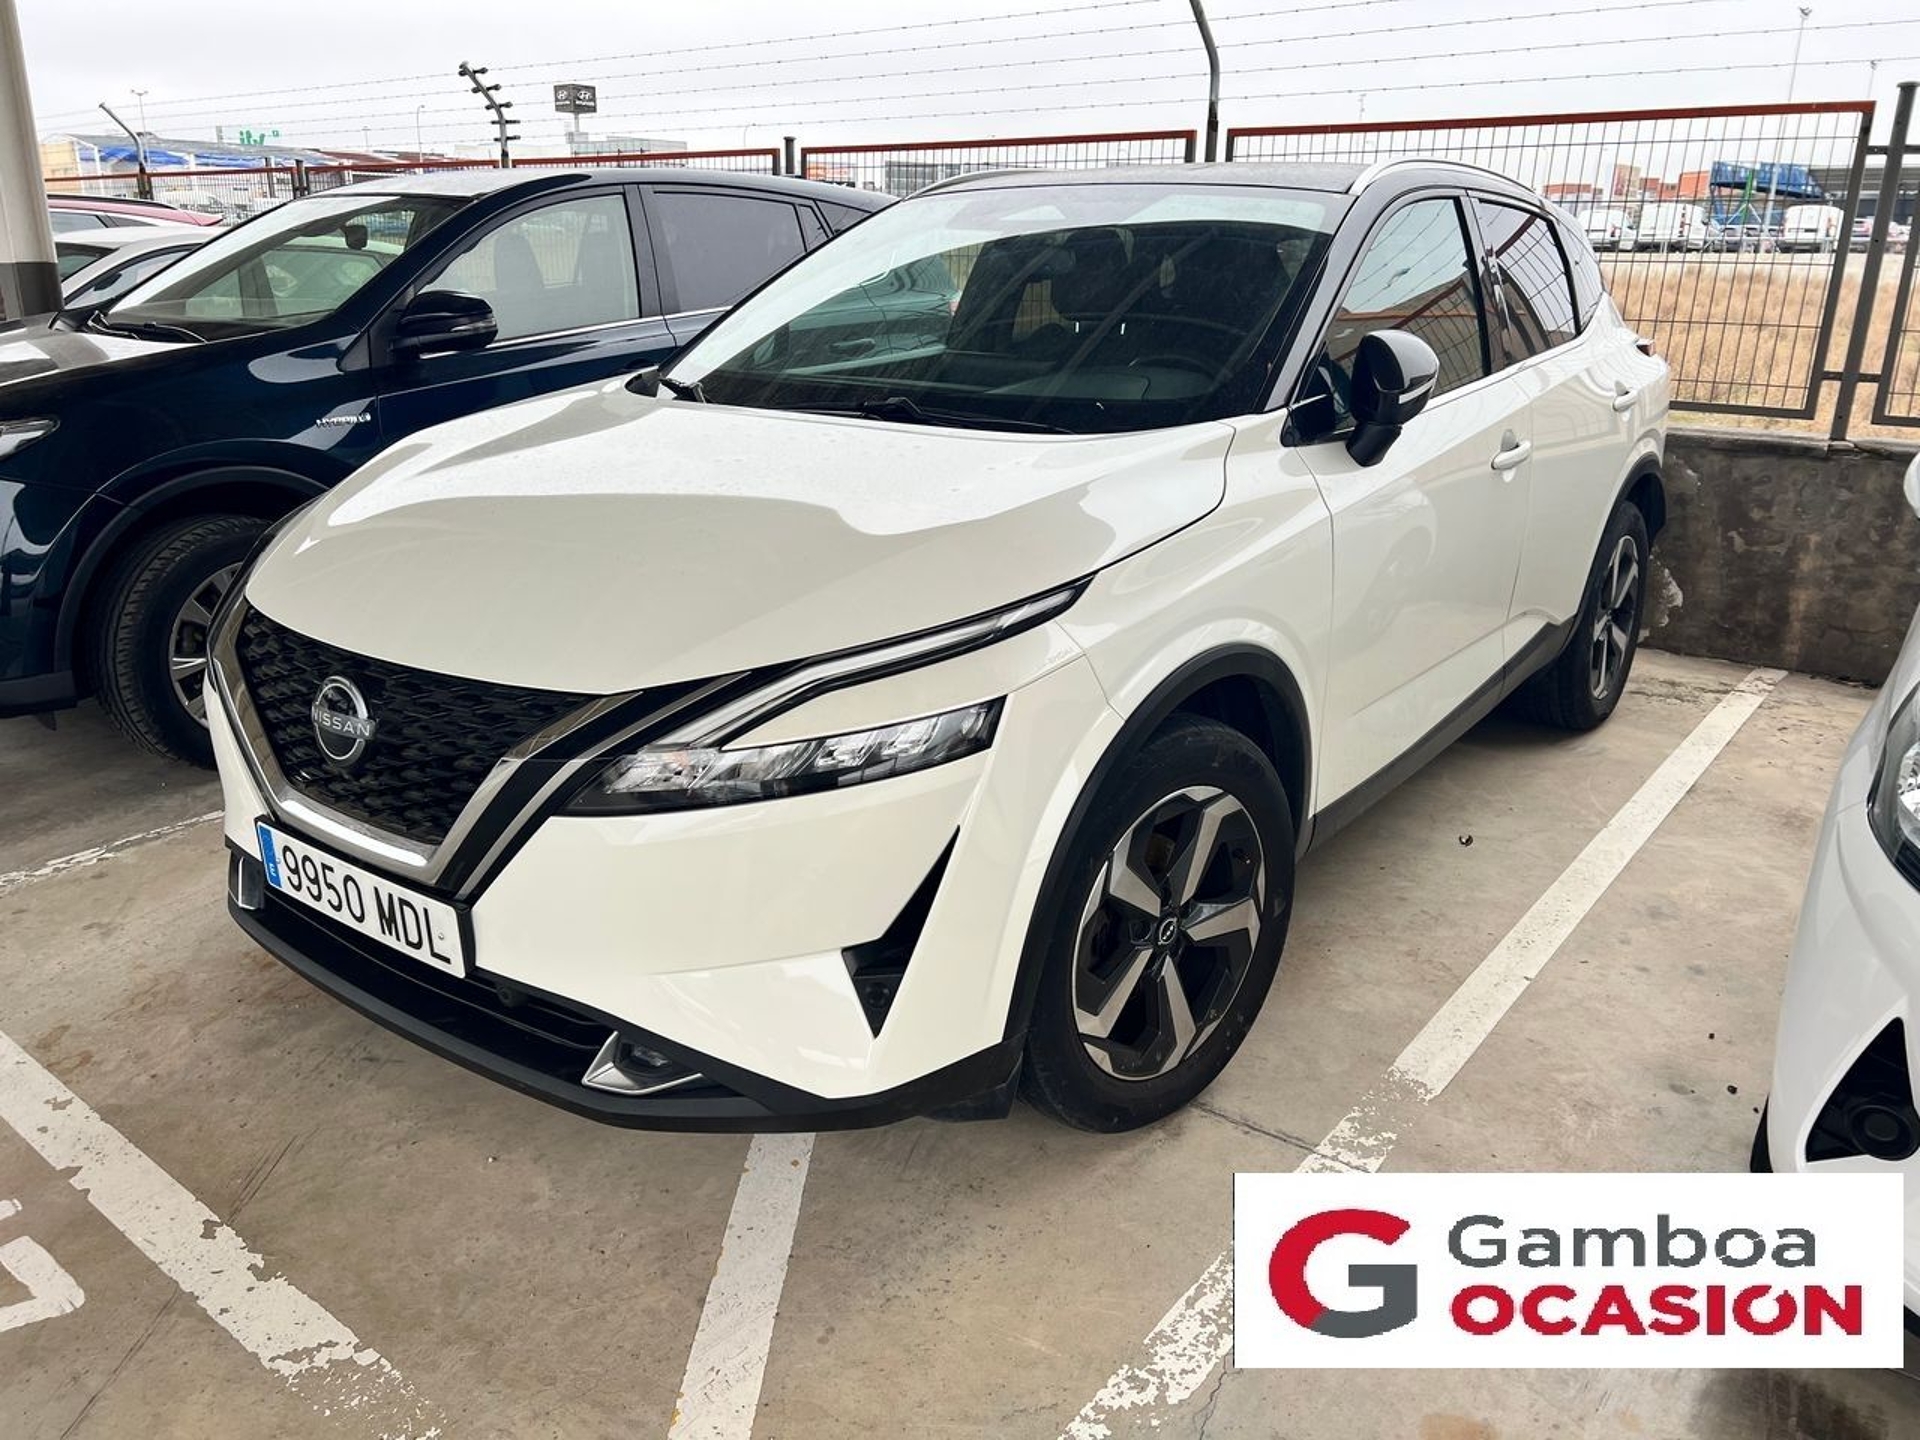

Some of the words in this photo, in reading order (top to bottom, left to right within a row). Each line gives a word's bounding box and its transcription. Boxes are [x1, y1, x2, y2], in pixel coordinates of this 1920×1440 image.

[313, 706, 370, 736] NISSAN
[282, 845, 365, 923] 9950
[374, 886, 451, 964] MDL
